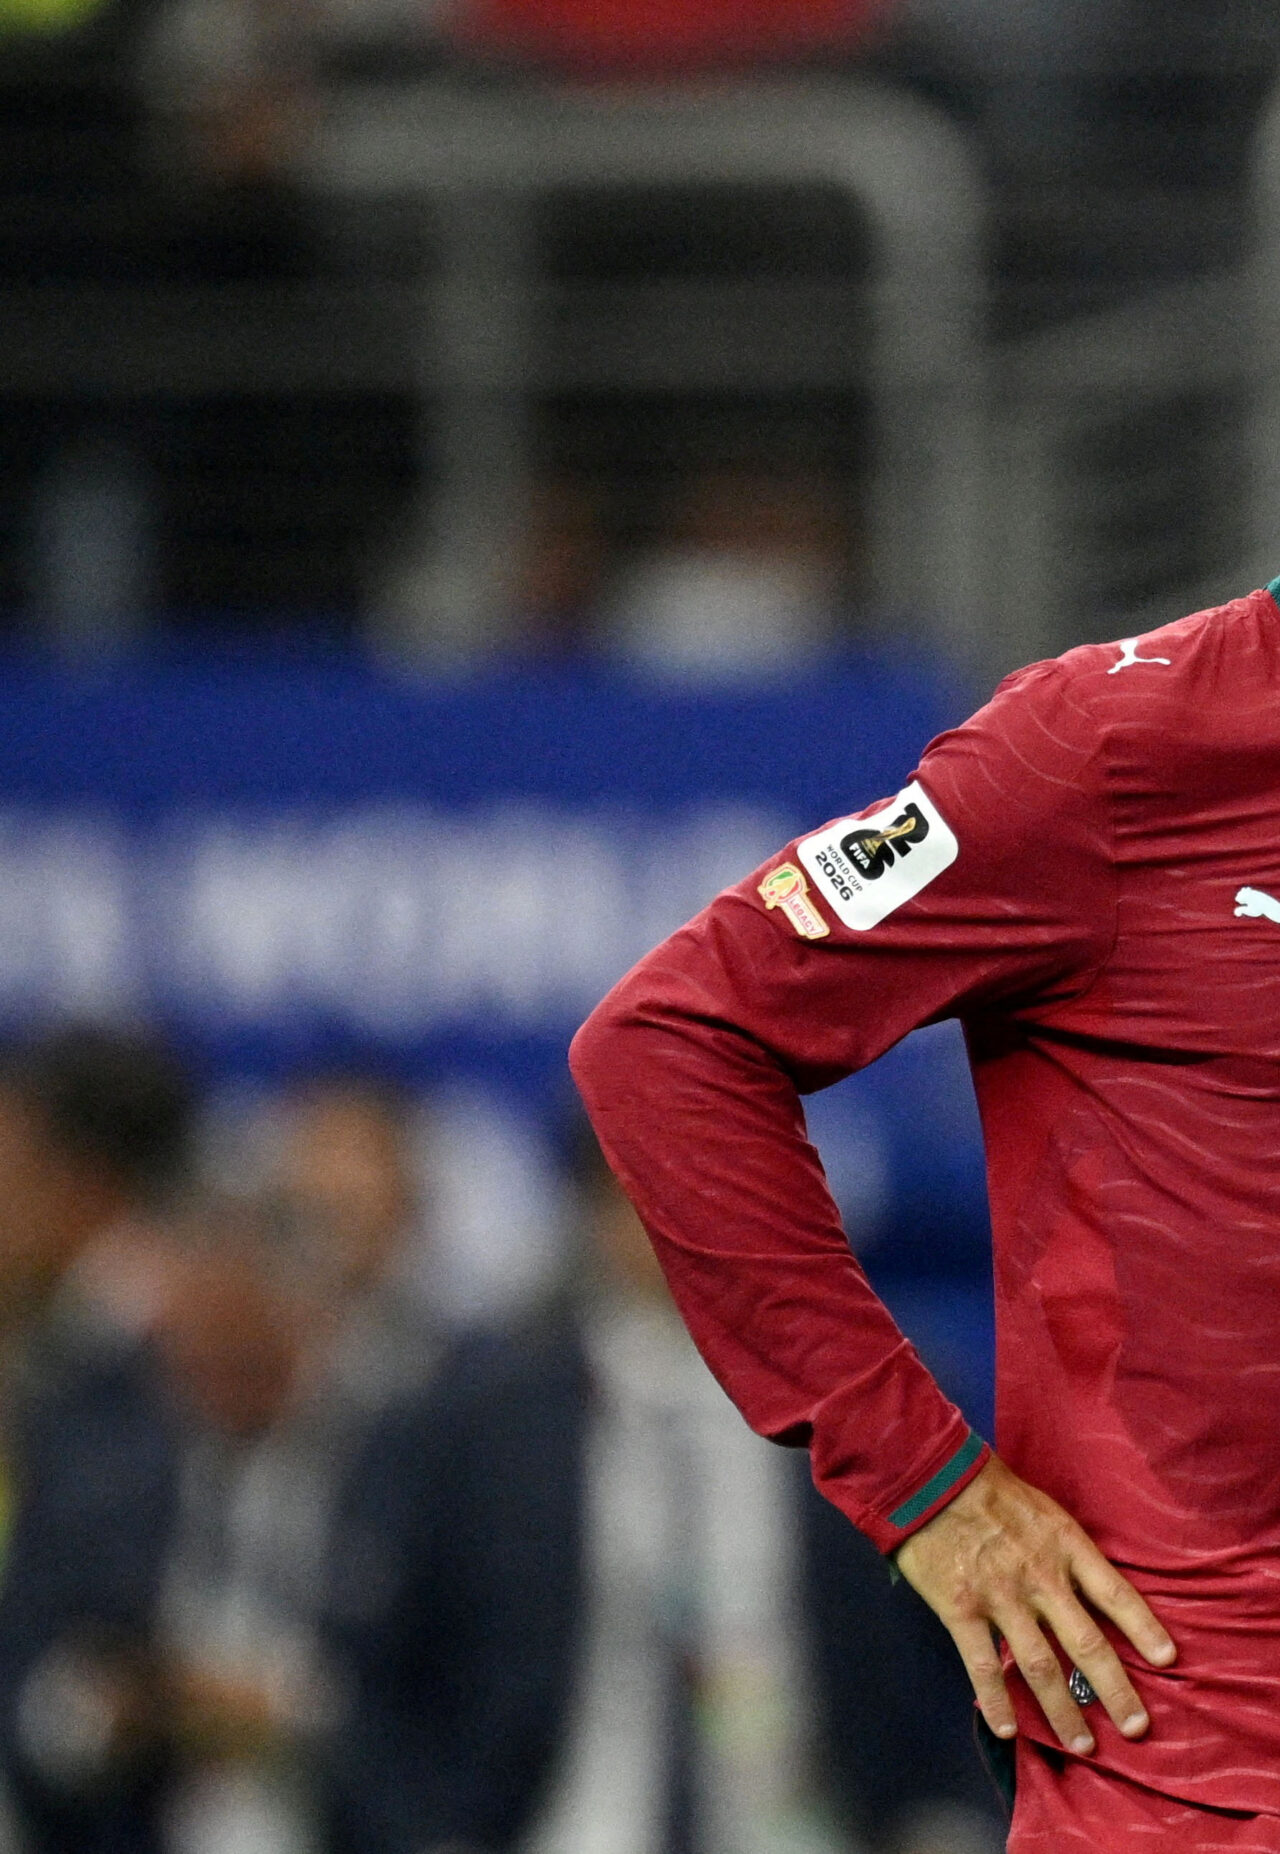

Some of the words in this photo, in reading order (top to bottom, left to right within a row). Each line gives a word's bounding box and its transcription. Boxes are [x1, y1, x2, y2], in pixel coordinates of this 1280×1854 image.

[827, 844, 851, 875] WORLD
[847, 875, 863, 892] CUP
[849, 842, 871, 869] FIFA
[815, 851, 854, 901] 2026
[790, 899, 815, 932] LEGACY
